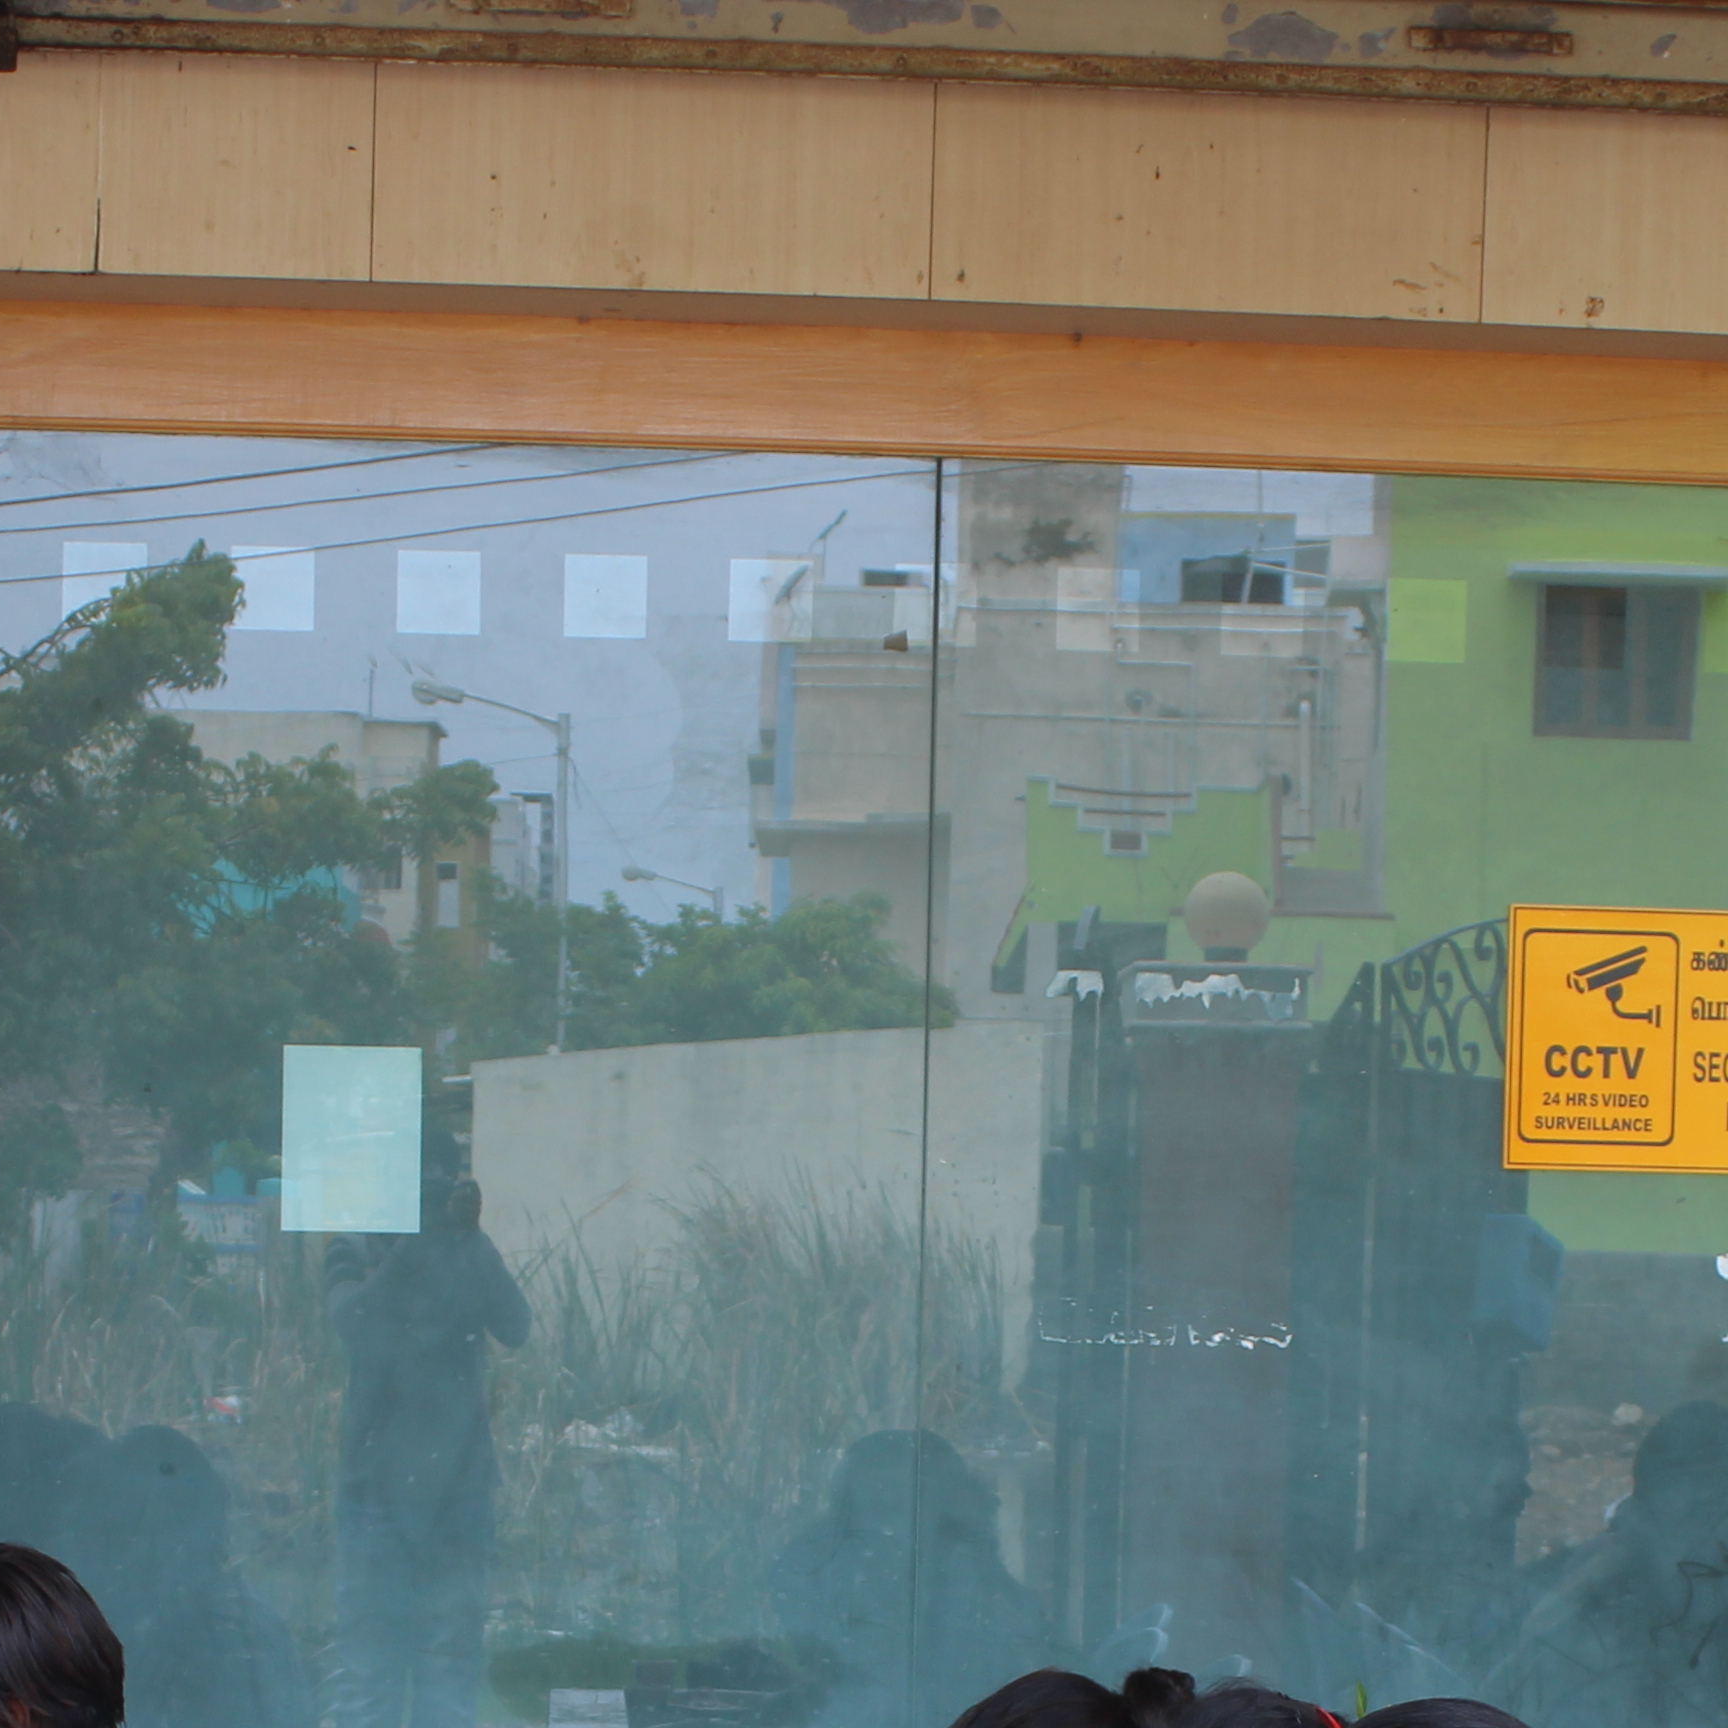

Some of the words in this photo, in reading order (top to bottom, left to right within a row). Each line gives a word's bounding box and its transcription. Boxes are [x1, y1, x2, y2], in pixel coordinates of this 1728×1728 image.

[1544, 1044, 1646, 1080] CCTV
[1542, 1091, 1561, 1106] 24
[1565, 1092, 1599, 1108] HRS
[1601, 1094, 1650, 1109] VIDEO
[1534, 1115, 1653, 1133] SURVEILLANCE
